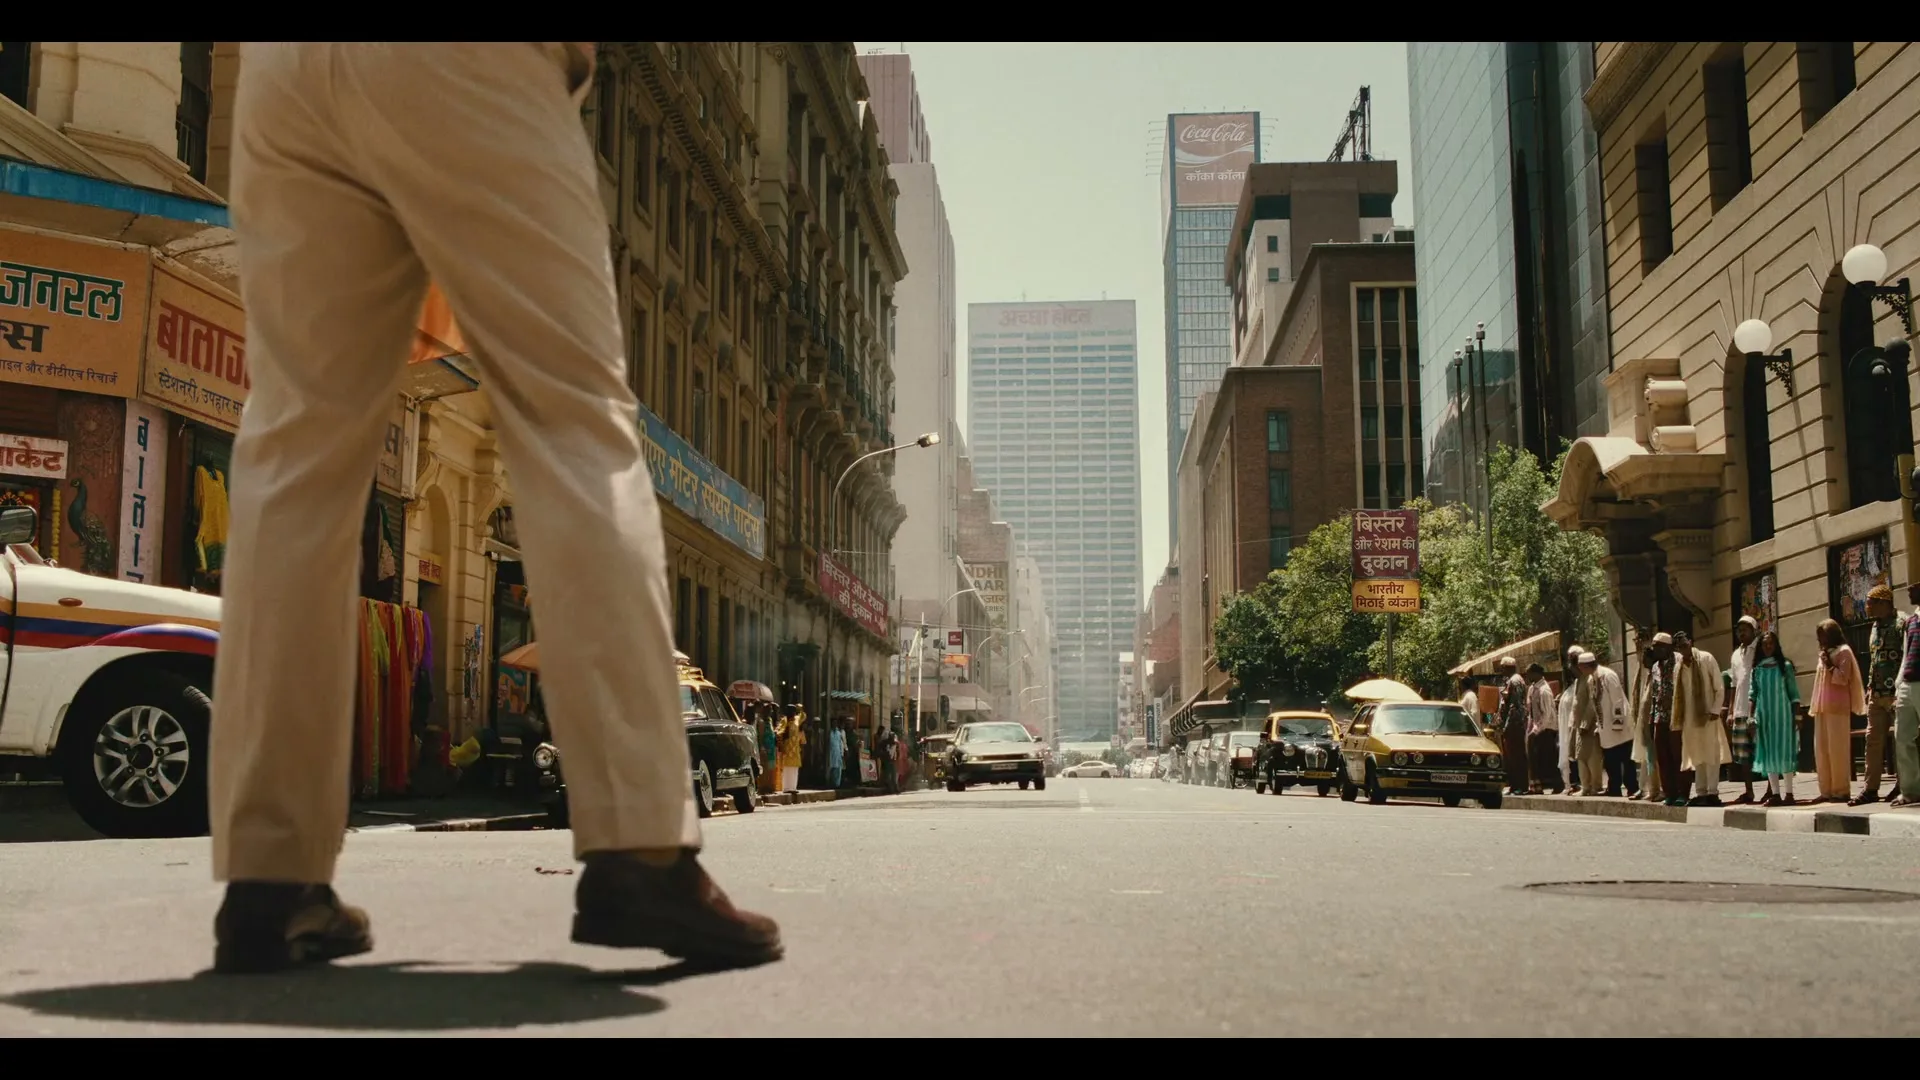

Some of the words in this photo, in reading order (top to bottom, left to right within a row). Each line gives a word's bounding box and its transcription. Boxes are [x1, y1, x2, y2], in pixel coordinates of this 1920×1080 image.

[1180, 123, 1248, 143] Coca-Cola
[0, 260, 125, 322] जनरल
[158, 300, 251, 390] बालाज
[0, 358, 22, 375] ाइल
[25, 360, 44, 375] और
[45, 362, 85, 381] डीटीएच
[86, 367, 118, 385] रिचार्ज
[126, 416, 149, 584] बाला
[1355, 511, 1406, 533] बिस्तर
[1354, 536, 1373, 551] और
[1373, 534, 1401, 551] रेशम
[1402, 536, 1416, 550] की
[965, 566, 1003, 579] NDHI
[1360, 555, 1410, 577] दुकान
[822, 553, 851, 590] बिस्तर
[851, 580, 867, 602] और
[867, 588, 885, 616] रेशम
[973, 580, 1004, 592] AAR
[1367, 581, 1405, 595] भारतीय
[839, 590, 850, 609] की
[851, 599, 873, 624] दुकान
[984, 605, 1005, 613] ERIES
[1356, 595, 1385, 609] मिठाई
[1387, 596, 1418, 608] व्यंजन
